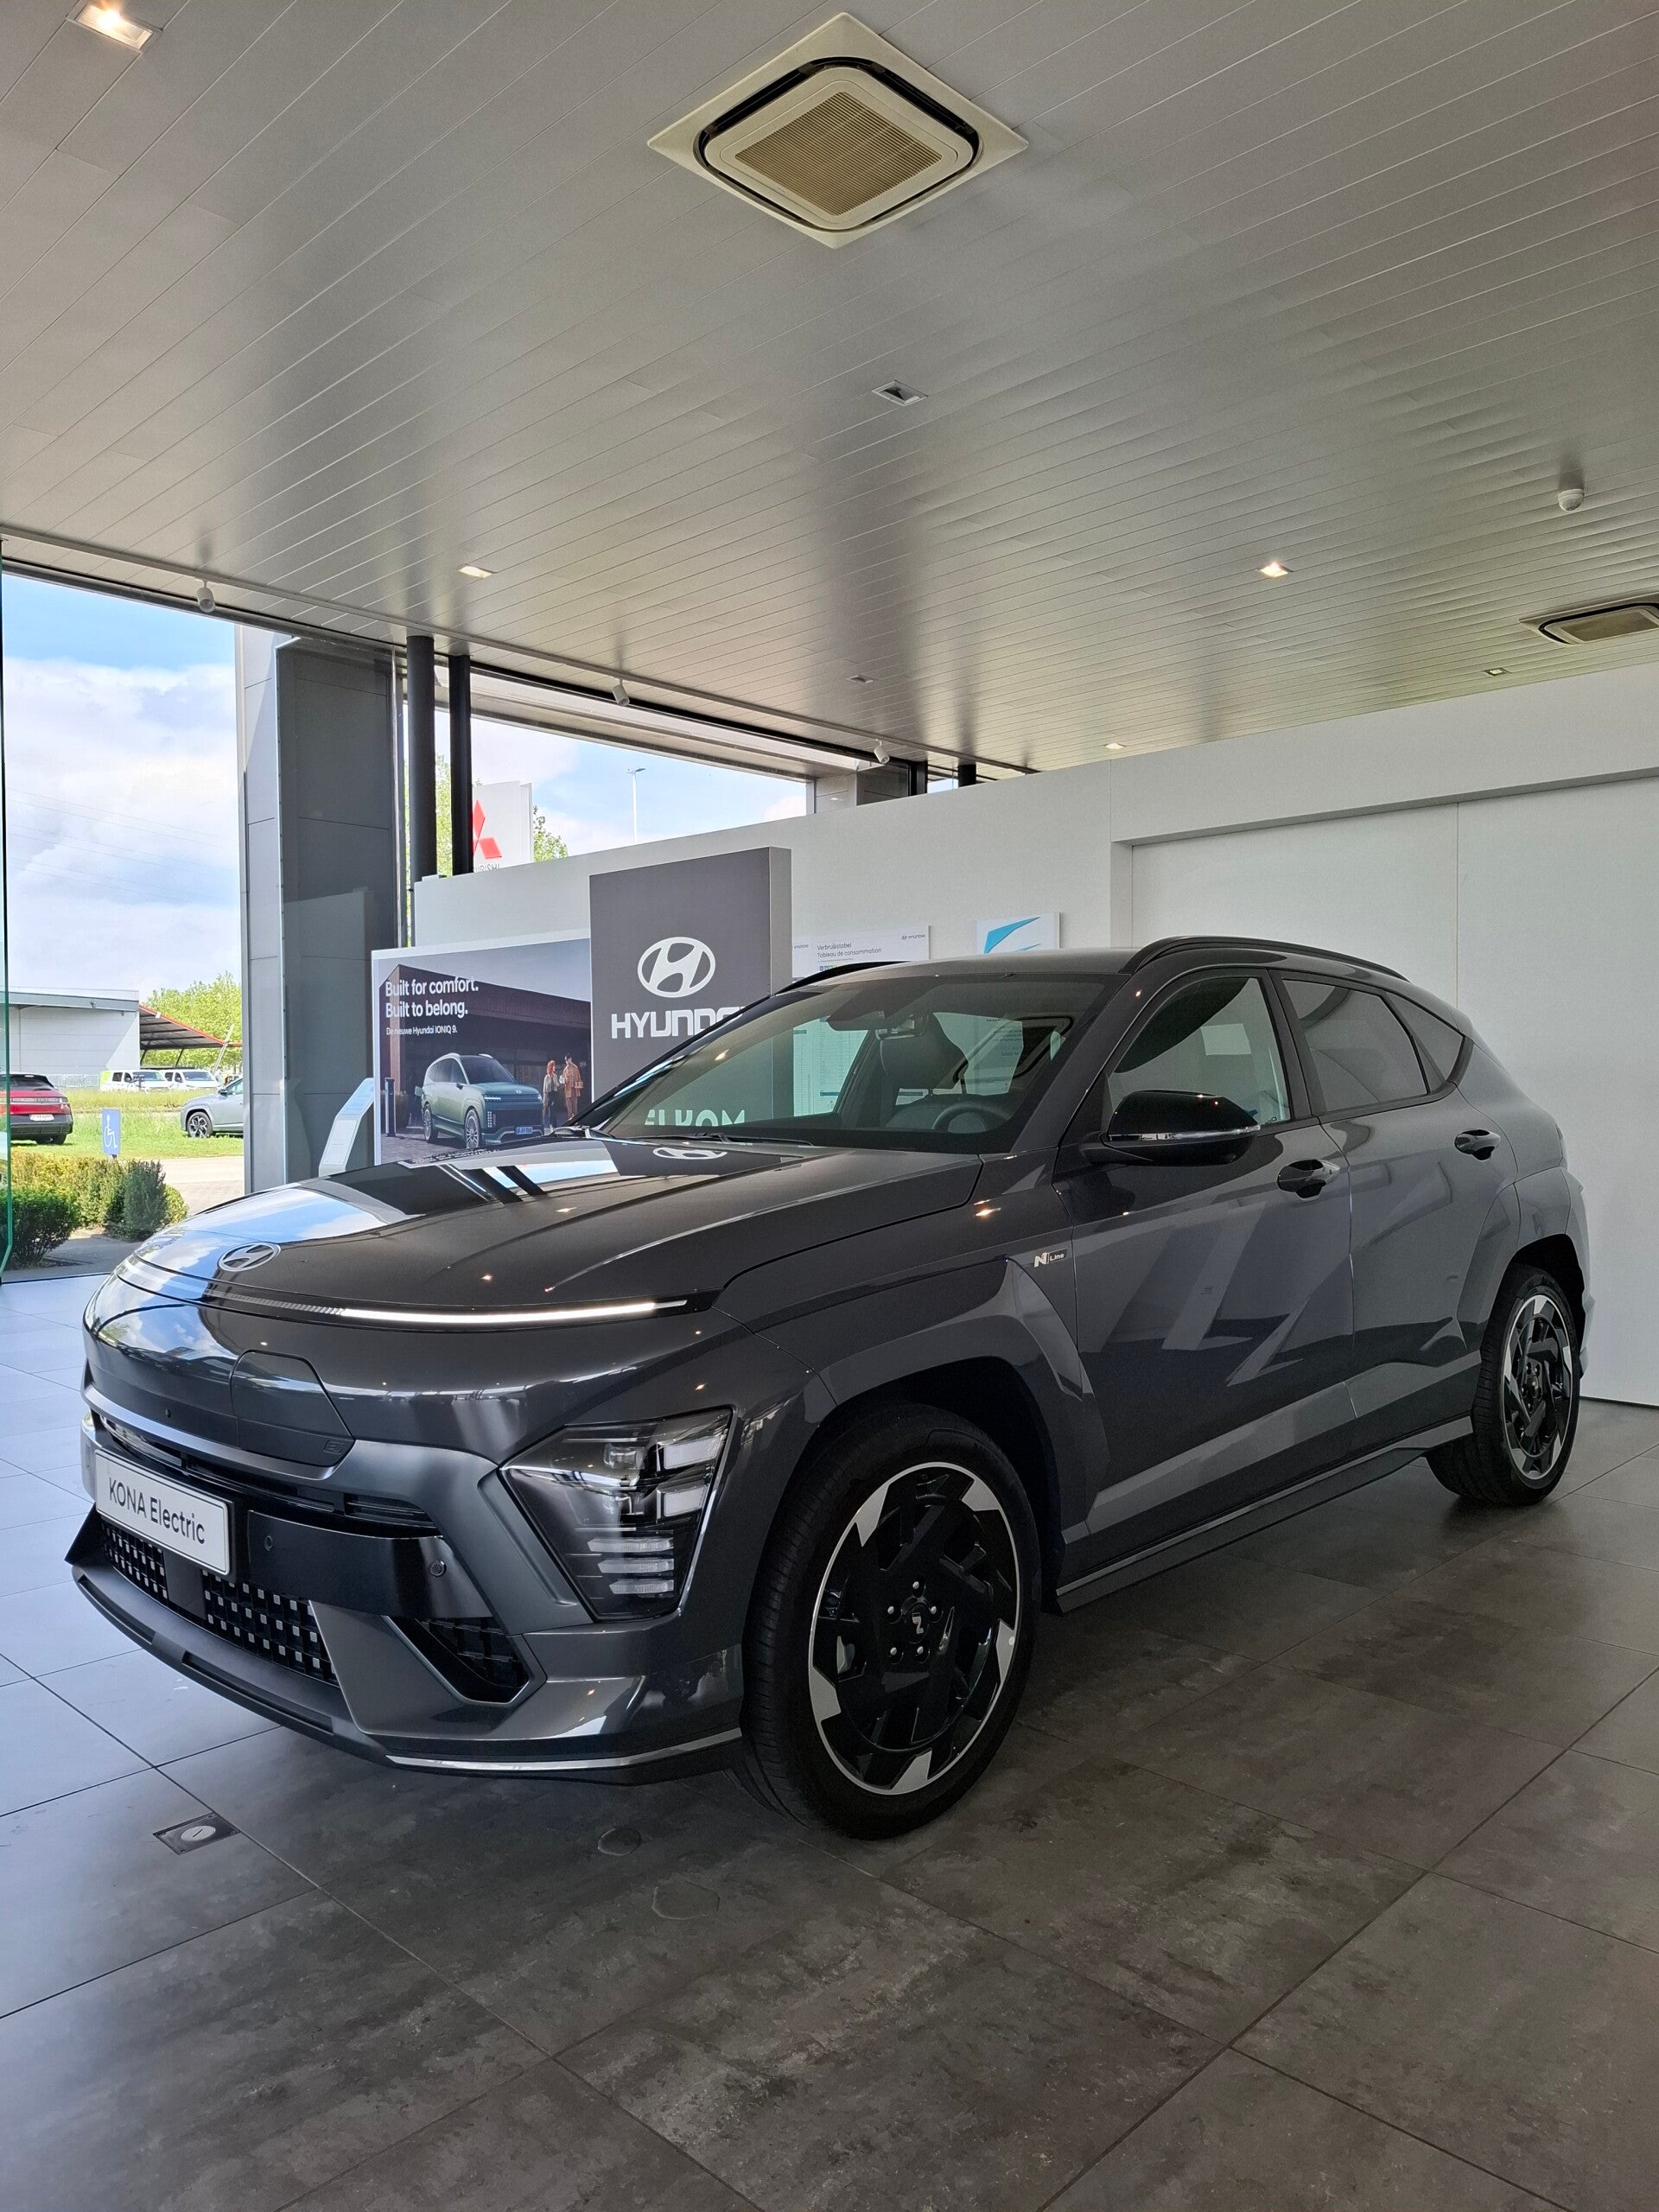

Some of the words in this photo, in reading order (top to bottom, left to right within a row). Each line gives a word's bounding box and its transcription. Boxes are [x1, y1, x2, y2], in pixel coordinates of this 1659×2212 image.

[385, 980, 410, 996] Built
[411, 979, 427, 995] for
[429, 976, 479, 995] comfort.
[385, 1001, 410, 1018] Built
[411, 1001, 423, 1017] to
[425, 999, 468, 1019] belong.
[394, 1027, 412, 1035] nieuwe
[412, 1025, 434, 1036] Hyundai
[435, 1025, 452, 1035] IONIQ
[452, 1024, 458, 1033] 9.
[611, 1007, 745, 1039] HYUND
[1050, 1253, 1065, 1262] Line
[109, 1477, 147, 1518] KONA
[150, 1497, 205, 1544] Electric
